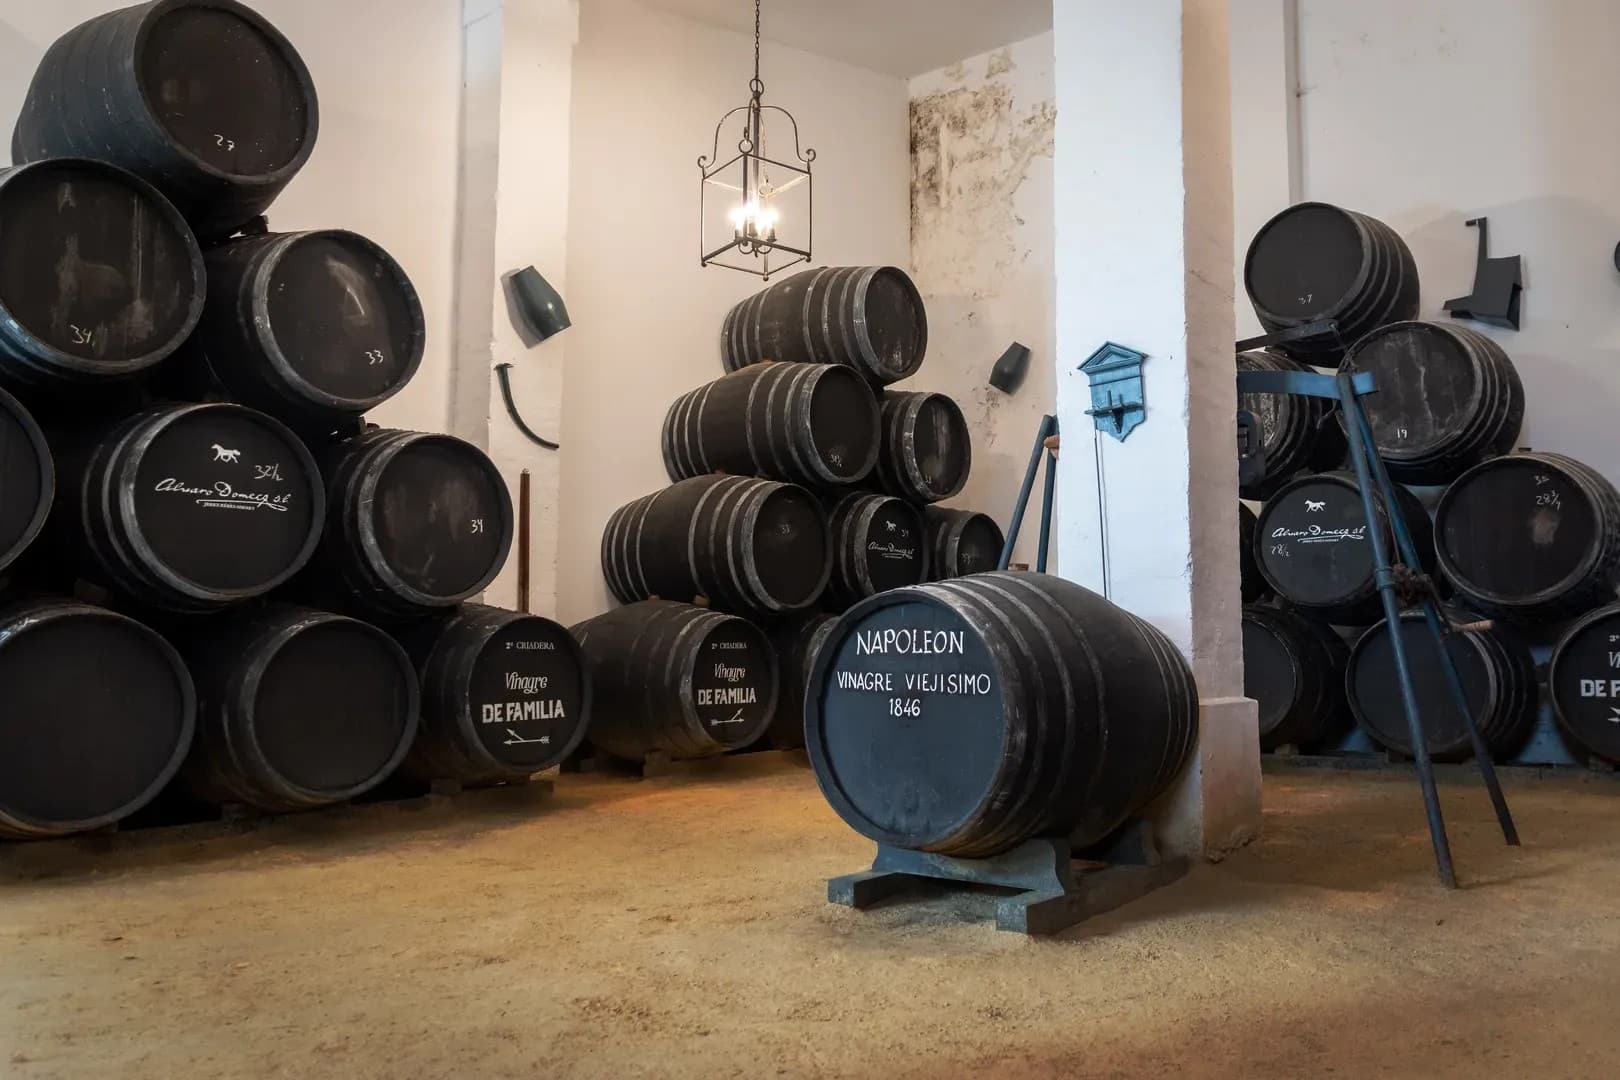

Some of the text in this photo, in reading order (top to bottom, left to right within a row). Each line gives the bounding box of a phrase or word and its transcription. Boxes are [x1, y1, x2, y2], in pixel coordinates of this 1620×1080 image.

[365, 350, 384, 365] 33
[1397, 428, 1408, 439] 19
[516, 640, 555, 650] CRIADERA
[856, 628, 964, 656] NAPOLEON
[505, 671, 548, 694] Vinagre
[714, 662, 746, 683] Vinagre
[837, 670, 991, 695] VINAGRE VIEJISIMO
[698, 687, 757, 706] DE FAMILIA
[1580, 679, 1607, 697] DE
[482, 699, 565, 723] DE FAMILIA
[888, 697, 921, 718] 1846
